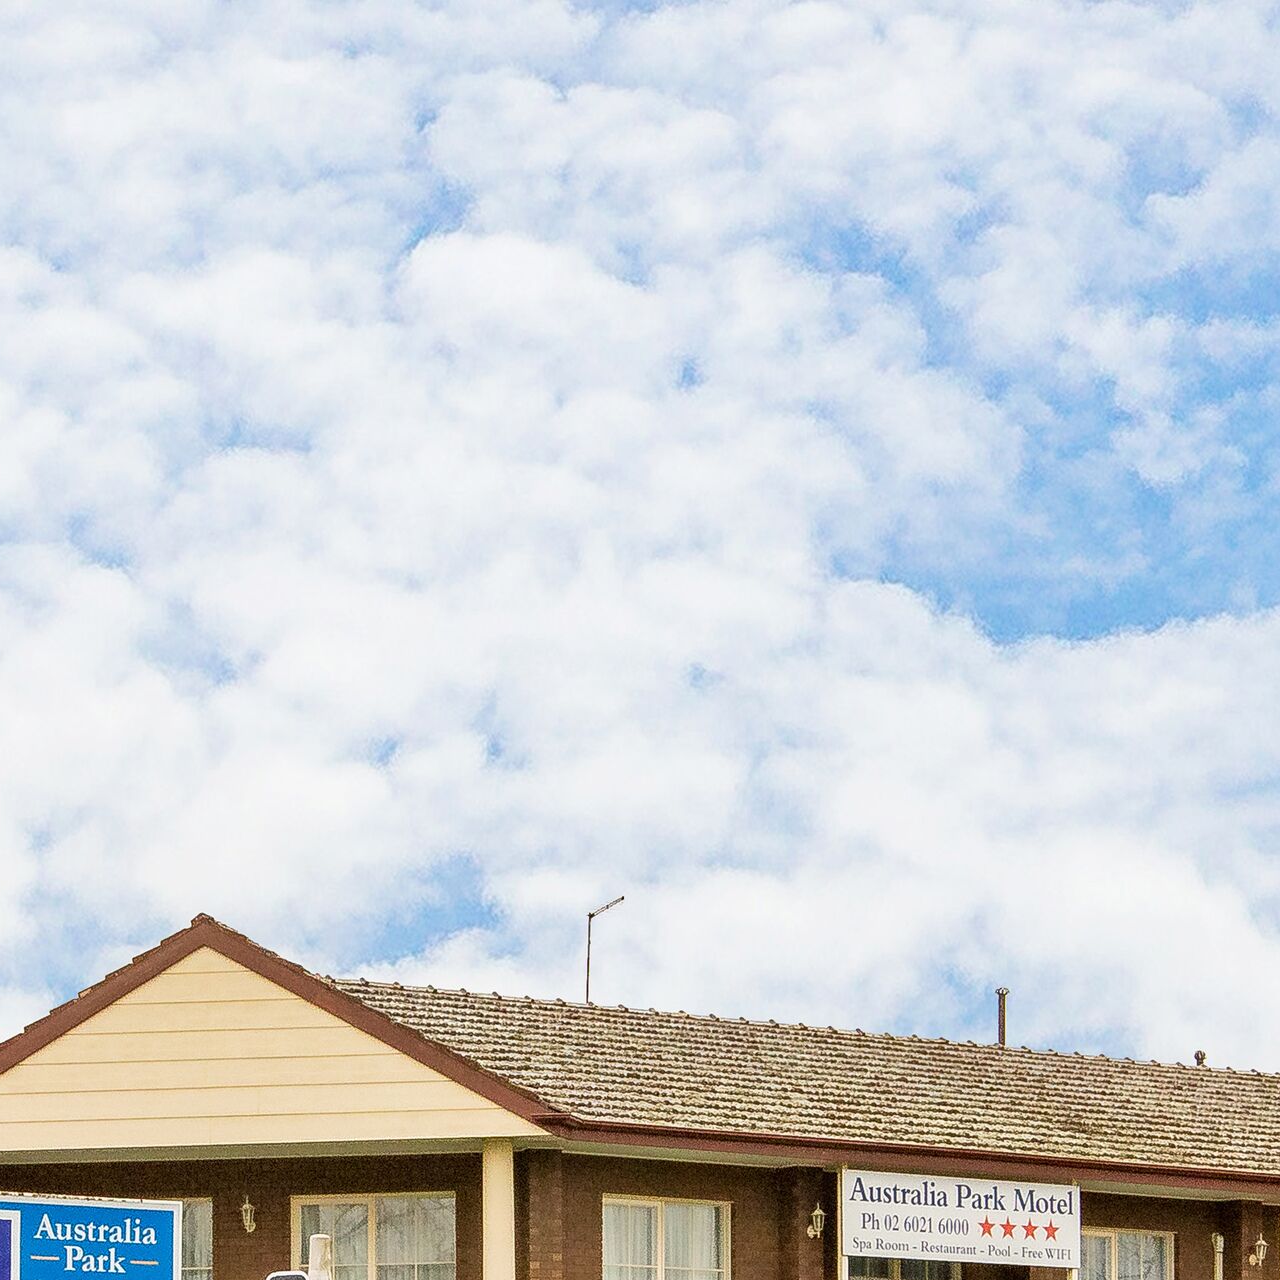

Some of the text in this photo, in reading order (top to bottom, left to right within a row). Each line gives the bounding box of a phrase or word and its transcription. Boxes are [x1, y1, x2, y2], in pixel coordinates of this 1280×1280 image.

[849, 1177, 1073, 1216] Australia Park Motel
[33, 1213, 157, 1245] Australia
[861, 1212, 969, 1236] Ph 02 6021 6000
[64, 1246, 126, 1274] Park
[852, 1237, 872, 1250] Spa
[875, 1239, 910, 1253] Room
[921, 1241, 977, 1257] Restaurant
[988, 1245, 1011, 1258] Pool
[1021, 1247, 1043, 1259] Free
[1045, 1249, 1071, 1261] WIFI
